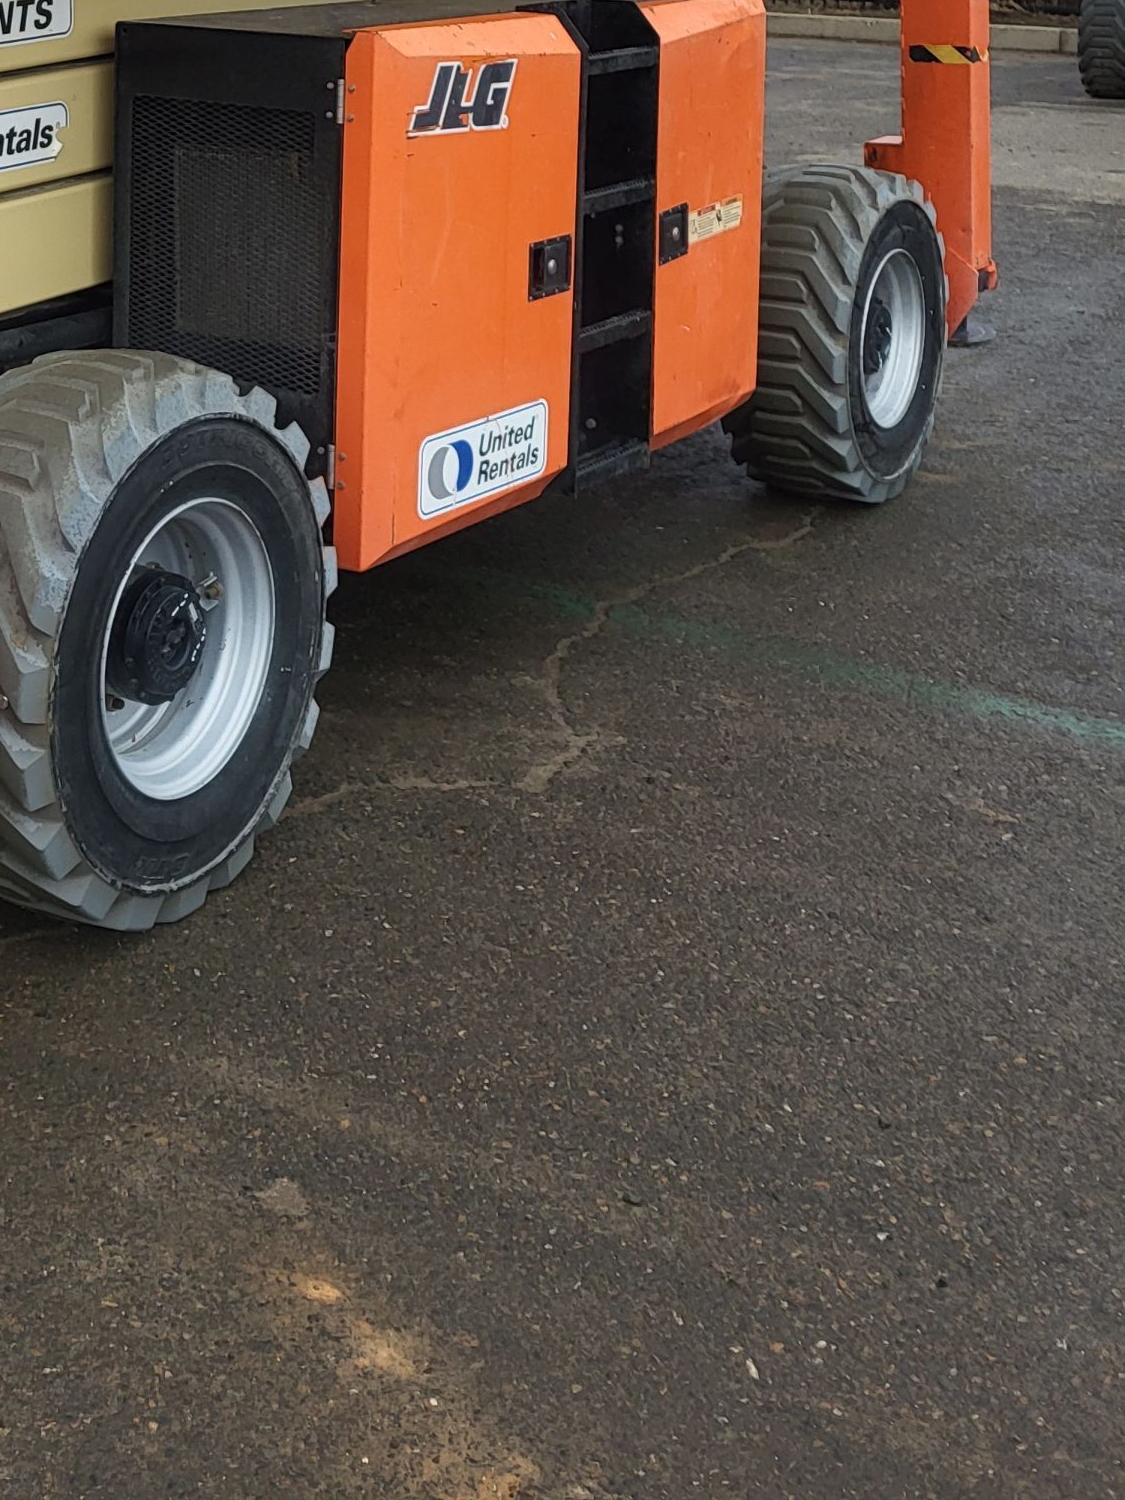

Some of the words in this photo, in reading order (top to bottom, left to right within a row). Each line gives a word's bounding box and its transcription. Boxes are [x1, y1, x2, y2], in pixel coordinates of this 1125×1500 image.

[406, 58, 518, 138] JLG
[478, 414, 535, 458] United
[476, 442, 540, 487] Rentals
